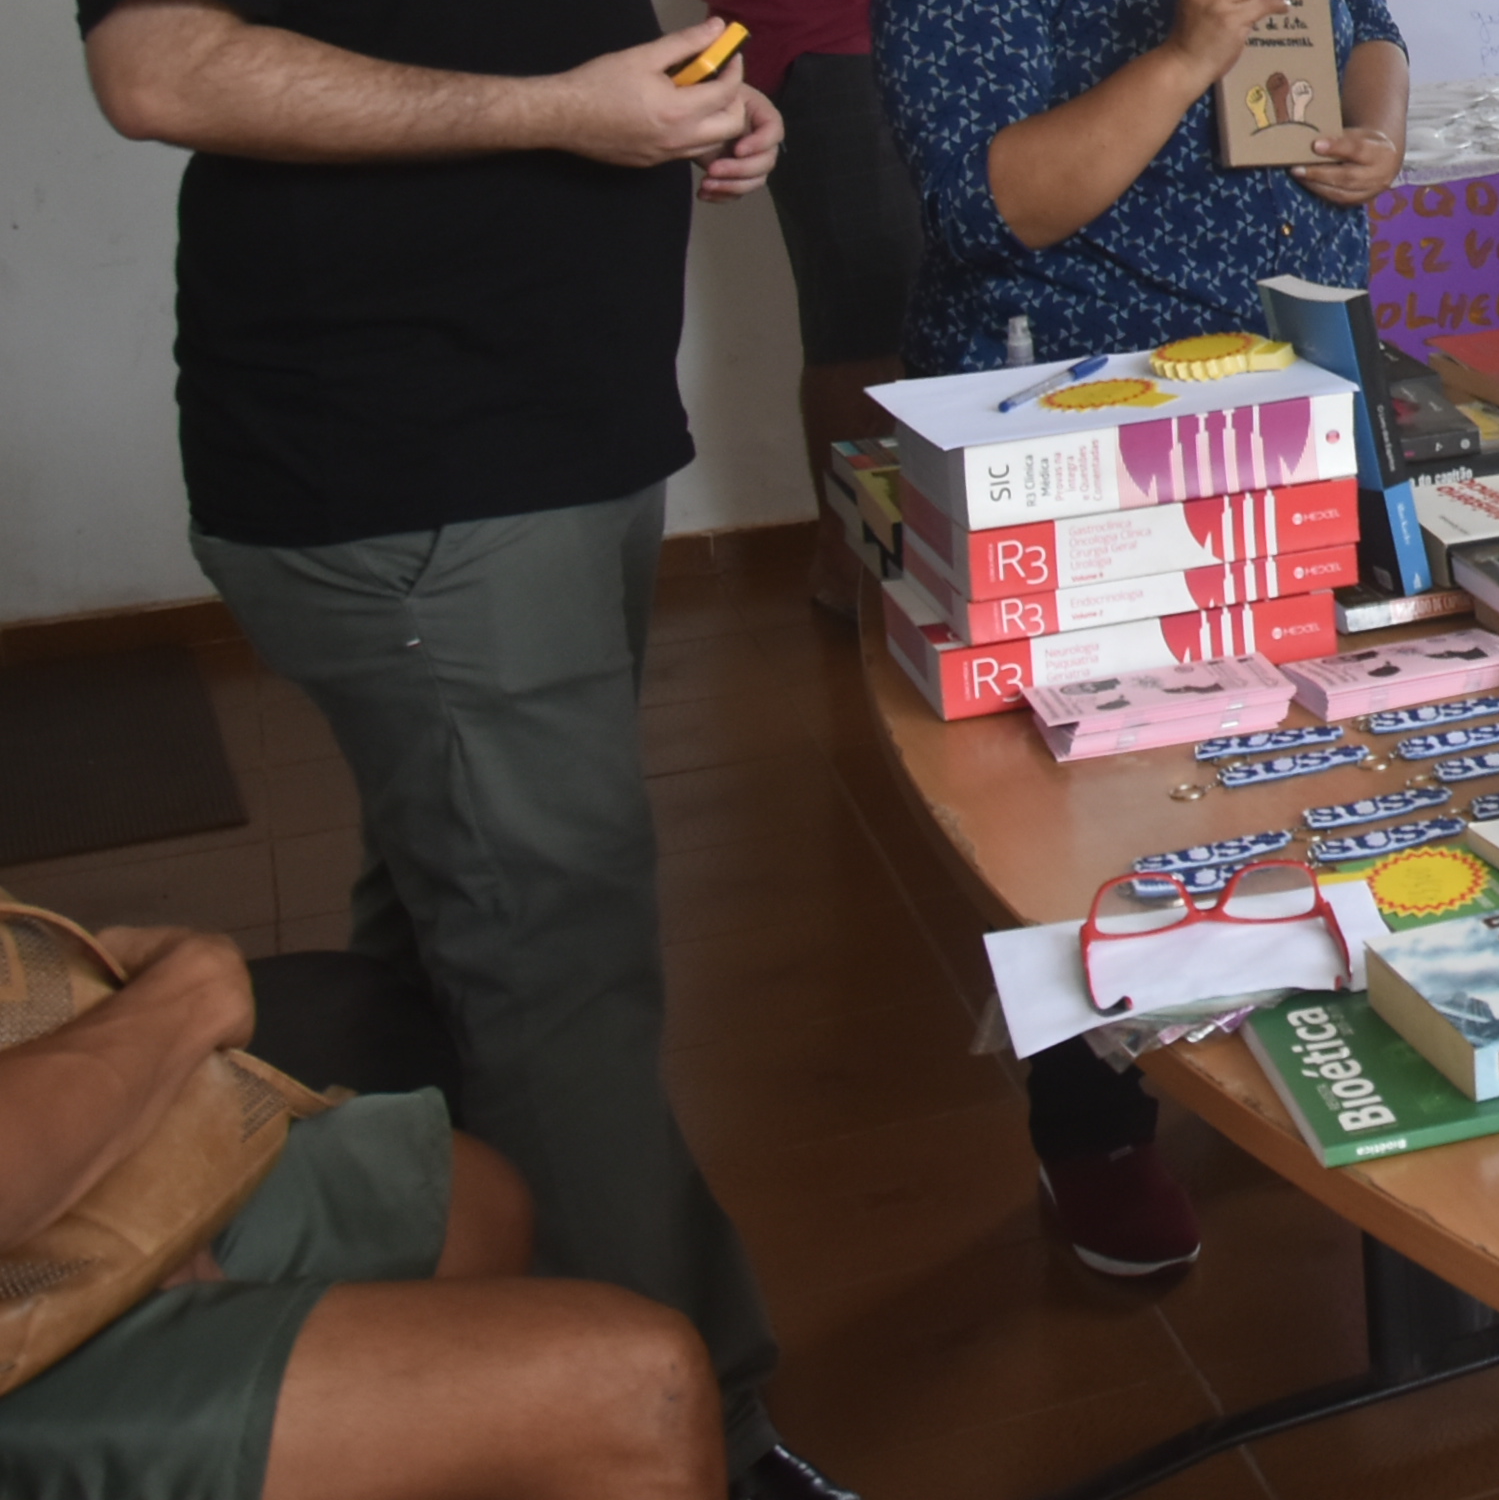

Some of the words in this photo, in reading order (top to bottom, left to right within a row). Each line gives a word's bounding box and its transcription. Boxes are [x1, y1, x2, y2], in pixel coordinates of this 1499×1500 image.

[988, 463, 1012, 503] SIC
[1040, 457, 1051, 497] Médica
[1110, 540, 1138, 552] Geral
[1120, 527, 1153, 540] Clínica
[997, 539, 1049, 586] R3
[1070, 589, 1144, 608] Endocrinologia
[1001, 598, 1047, 637] R3
[1045, 642, 1100, 659] Neurologia
[1045, 655, 1100, 670] Psiquiatria
[971, 657, 1024, 703] R3
[1286, 1004, 1398, 1134] Bioética
[1354, 1139, 1407, 1157] Bioética
